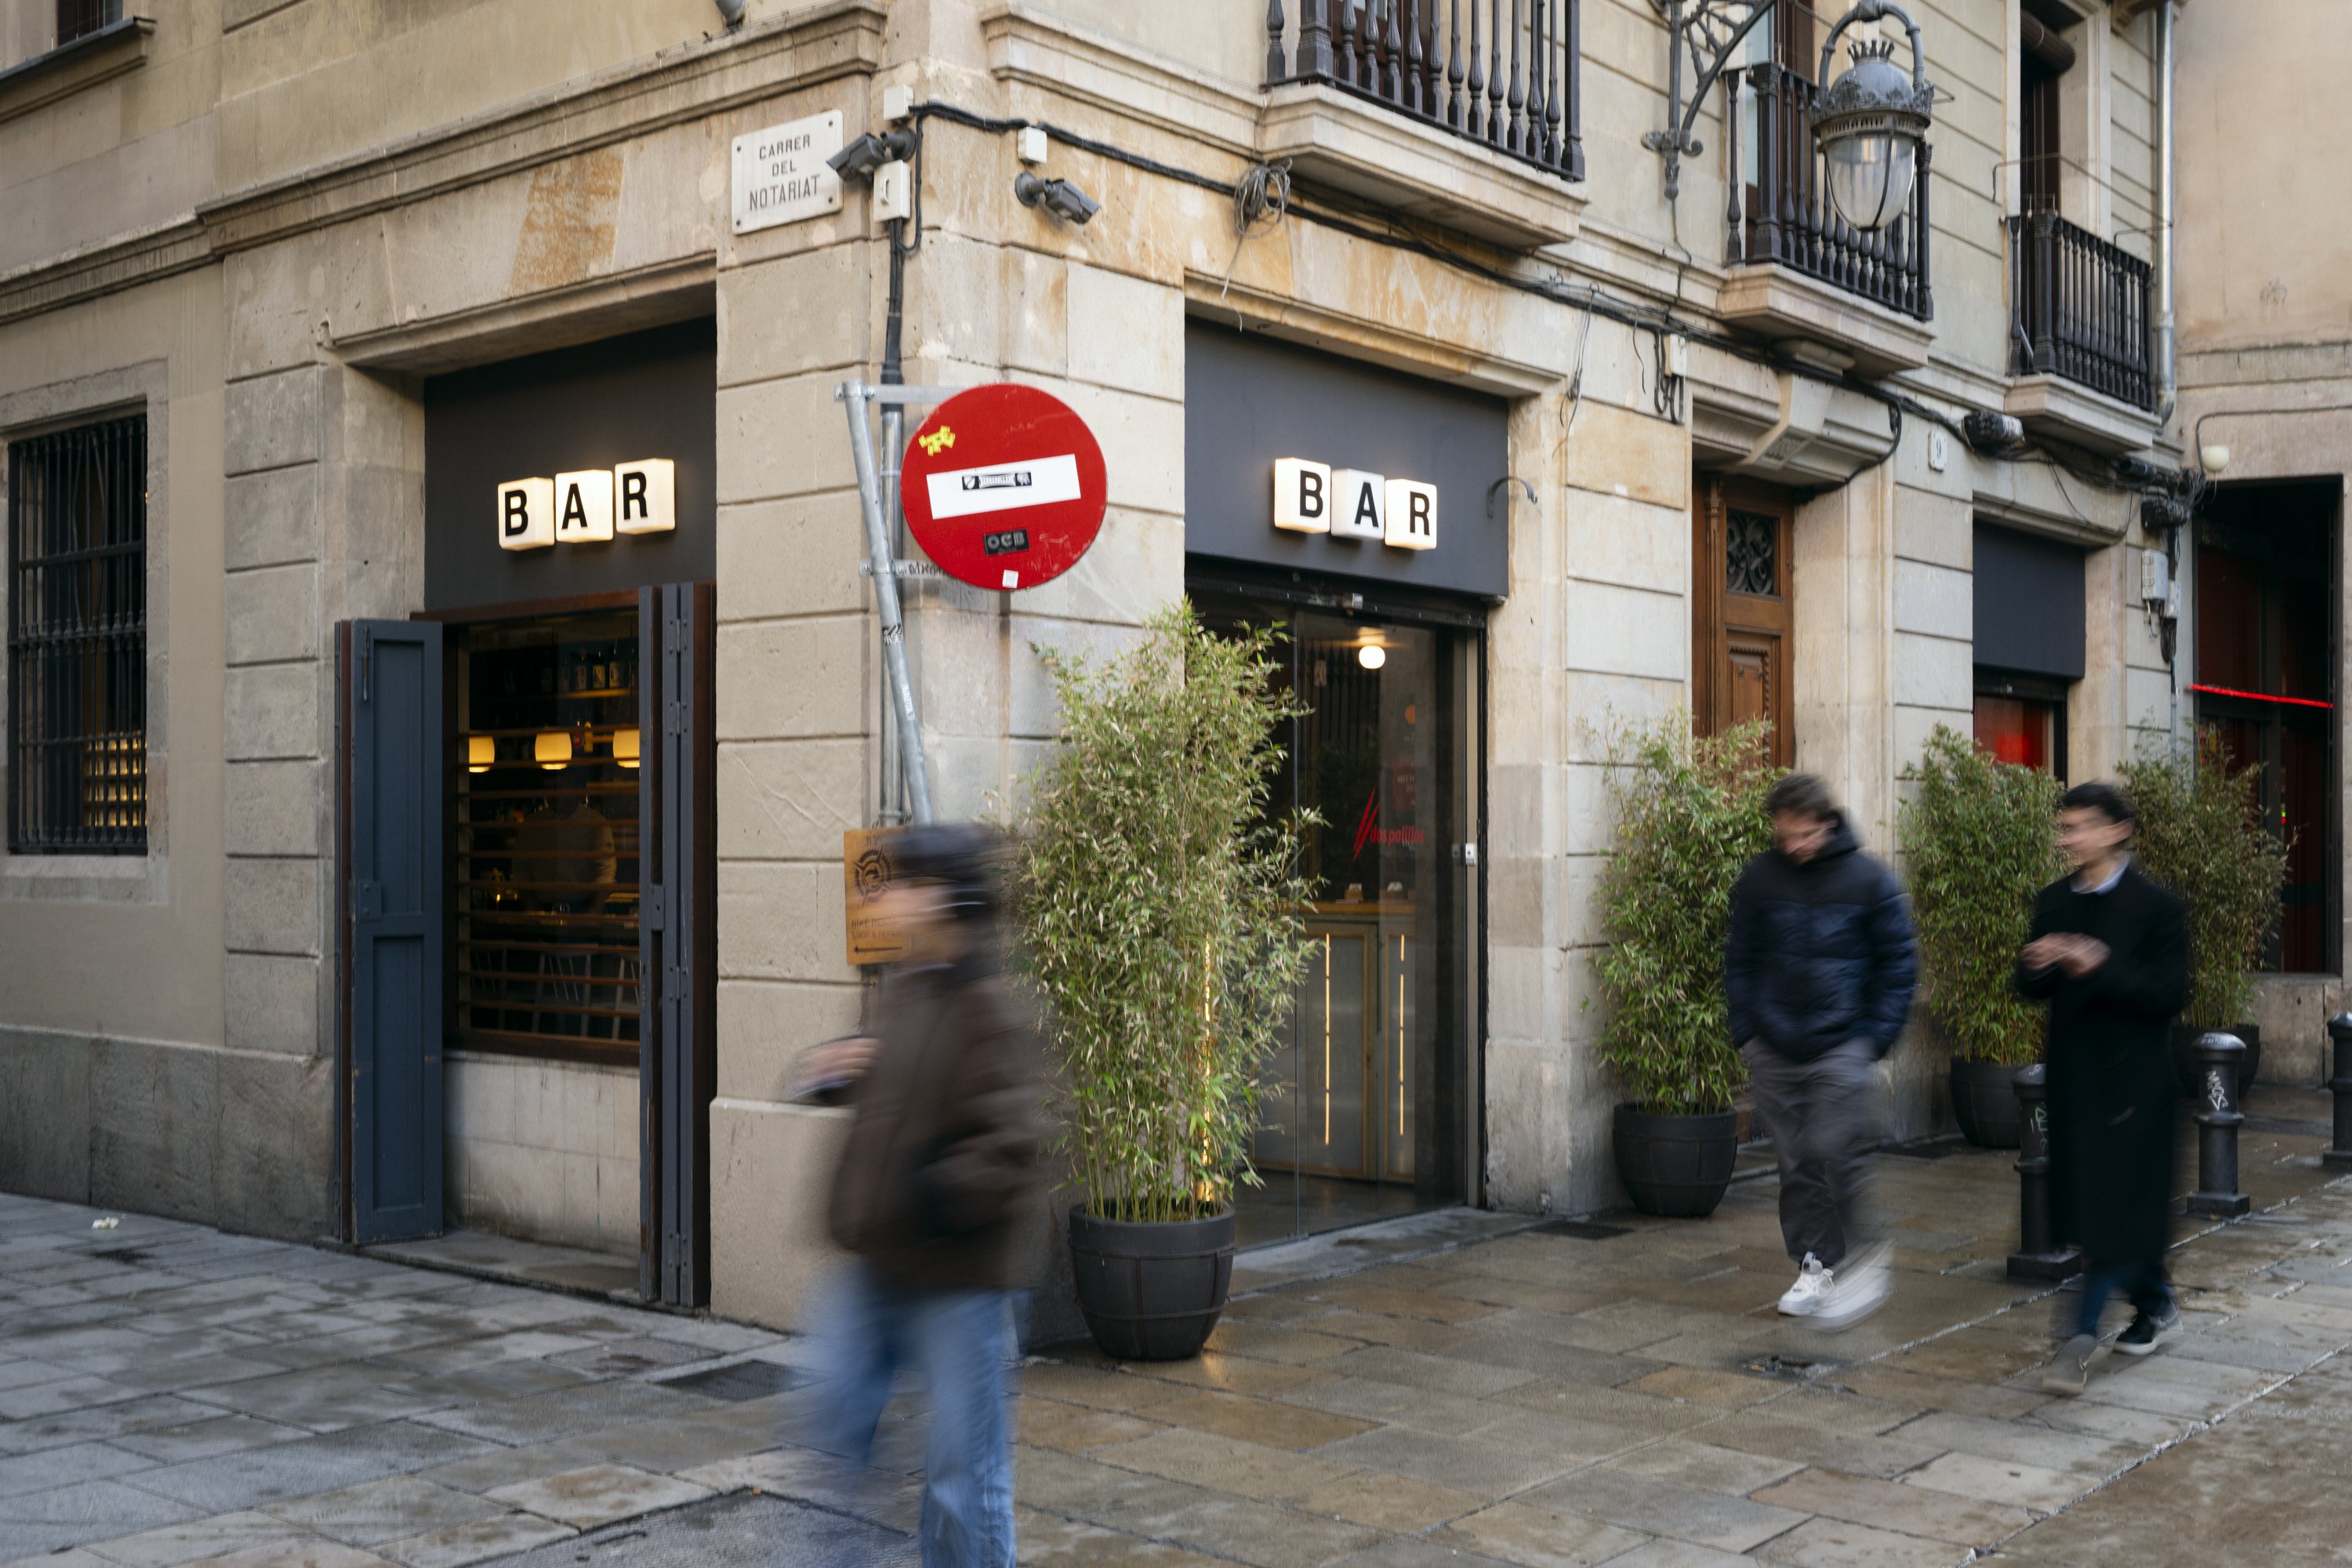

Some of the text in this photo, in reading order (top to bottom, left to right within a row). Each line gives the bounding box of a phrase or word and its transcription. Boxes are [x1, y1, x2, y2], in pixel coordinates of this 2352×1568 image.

[759, 133, 811, 160] CARRER
[771, 160, 797, 177] DEL
[750, 174, 821, 212] NOTARIAT
[1936, 438, 1942, 459] 9
[504, 470, 649, 538] BAR
[1299, 469, 1431, 536] BAR
[987, 531, 1025, 550] OCB
[1369, 825, 1387, 844] dos
[851, 918, 870, 930] BIKE
[851, 931, 869, 940] SHOP
[878, 929, 902, 939] REPAIR
